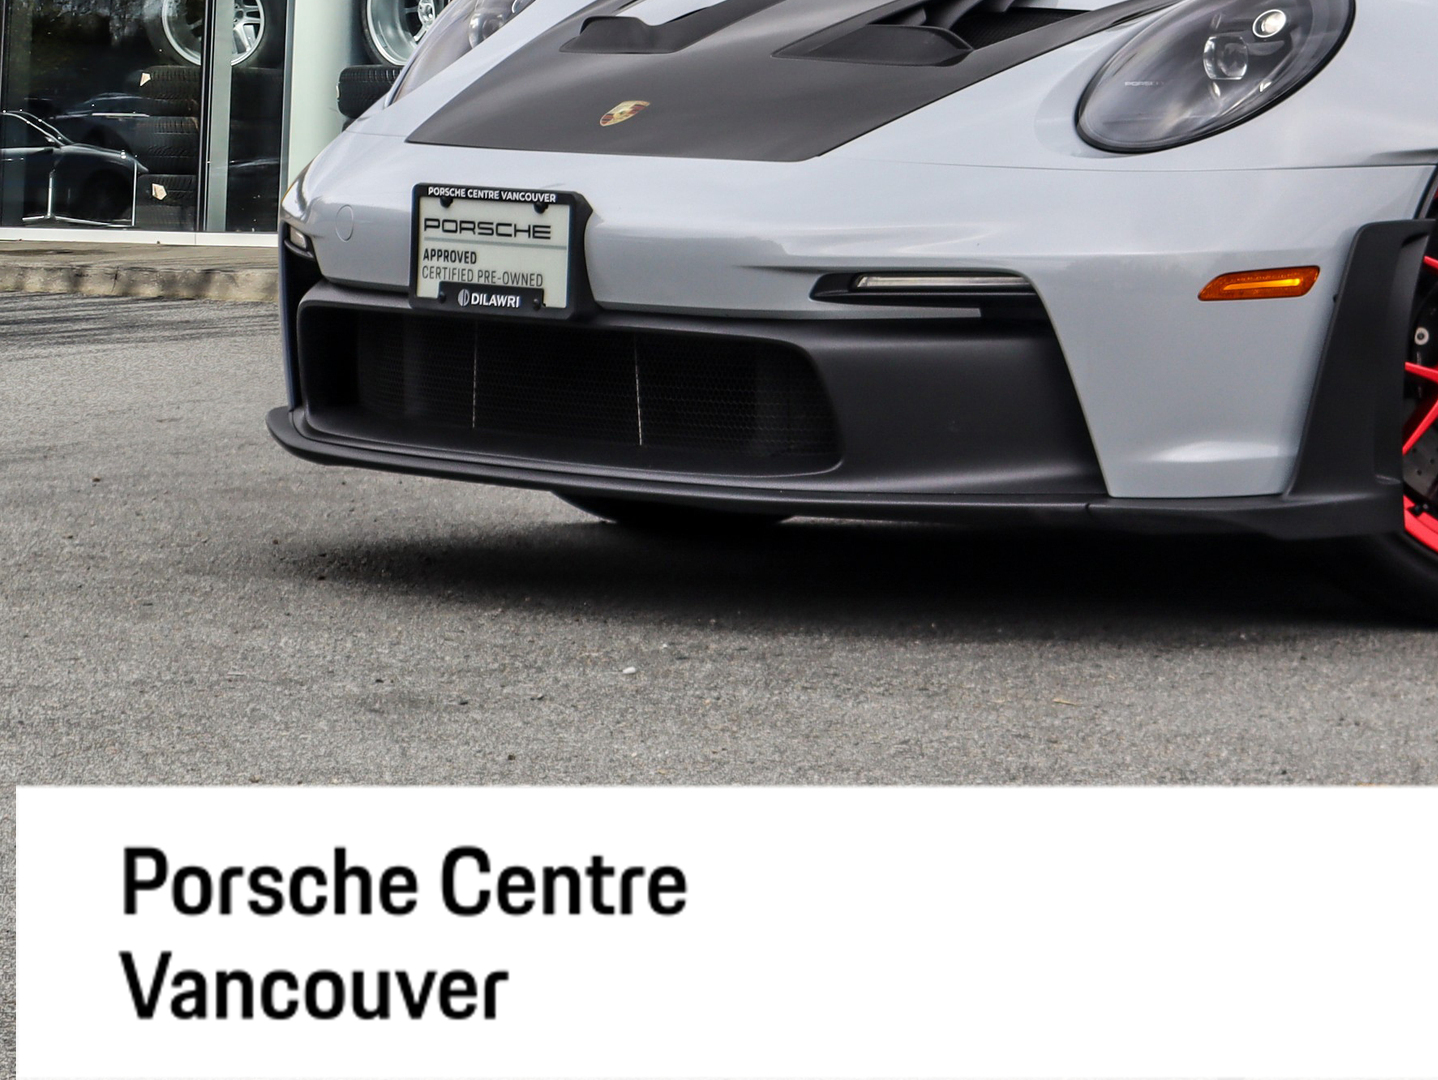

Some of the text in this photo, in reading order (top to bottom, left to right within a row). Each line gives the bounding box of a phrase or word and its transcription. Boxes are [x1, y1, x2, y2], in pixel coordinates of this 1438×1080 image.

[428, 186, 556, 203] PORSCHE CENTRE VANCOUVER
[424, 217, 551, 240] PORSCHE
[423, 248, 477, 265] APPROVED
[422, 265, 543, 287] CERTIFIED PRE-OWNED
[471, 293, 520, 308] DILAWRI
